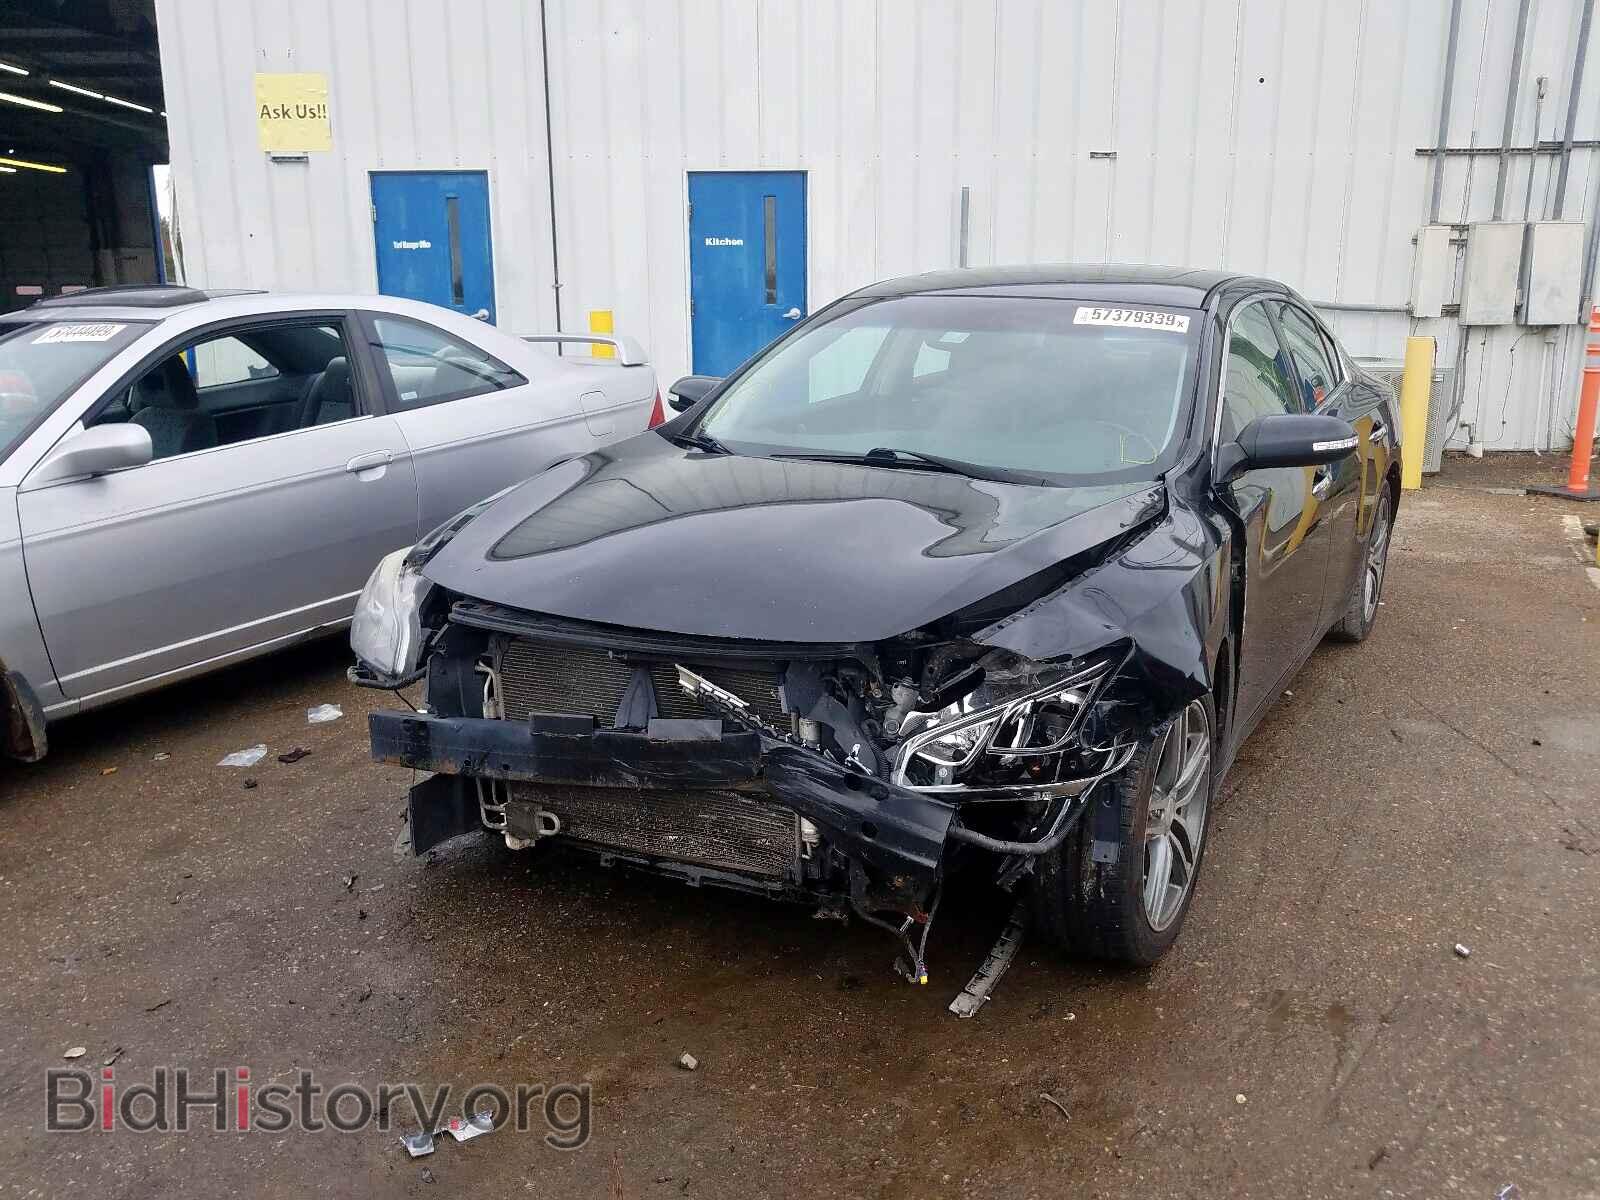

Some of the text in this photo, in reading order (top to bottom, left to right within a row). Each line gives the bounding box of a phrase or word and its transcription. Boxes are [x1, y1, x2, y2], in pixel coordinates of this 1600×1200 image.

[260, 103, 327, 119] Ask Us!!
[705, 237, 744, 246] Kitchen
